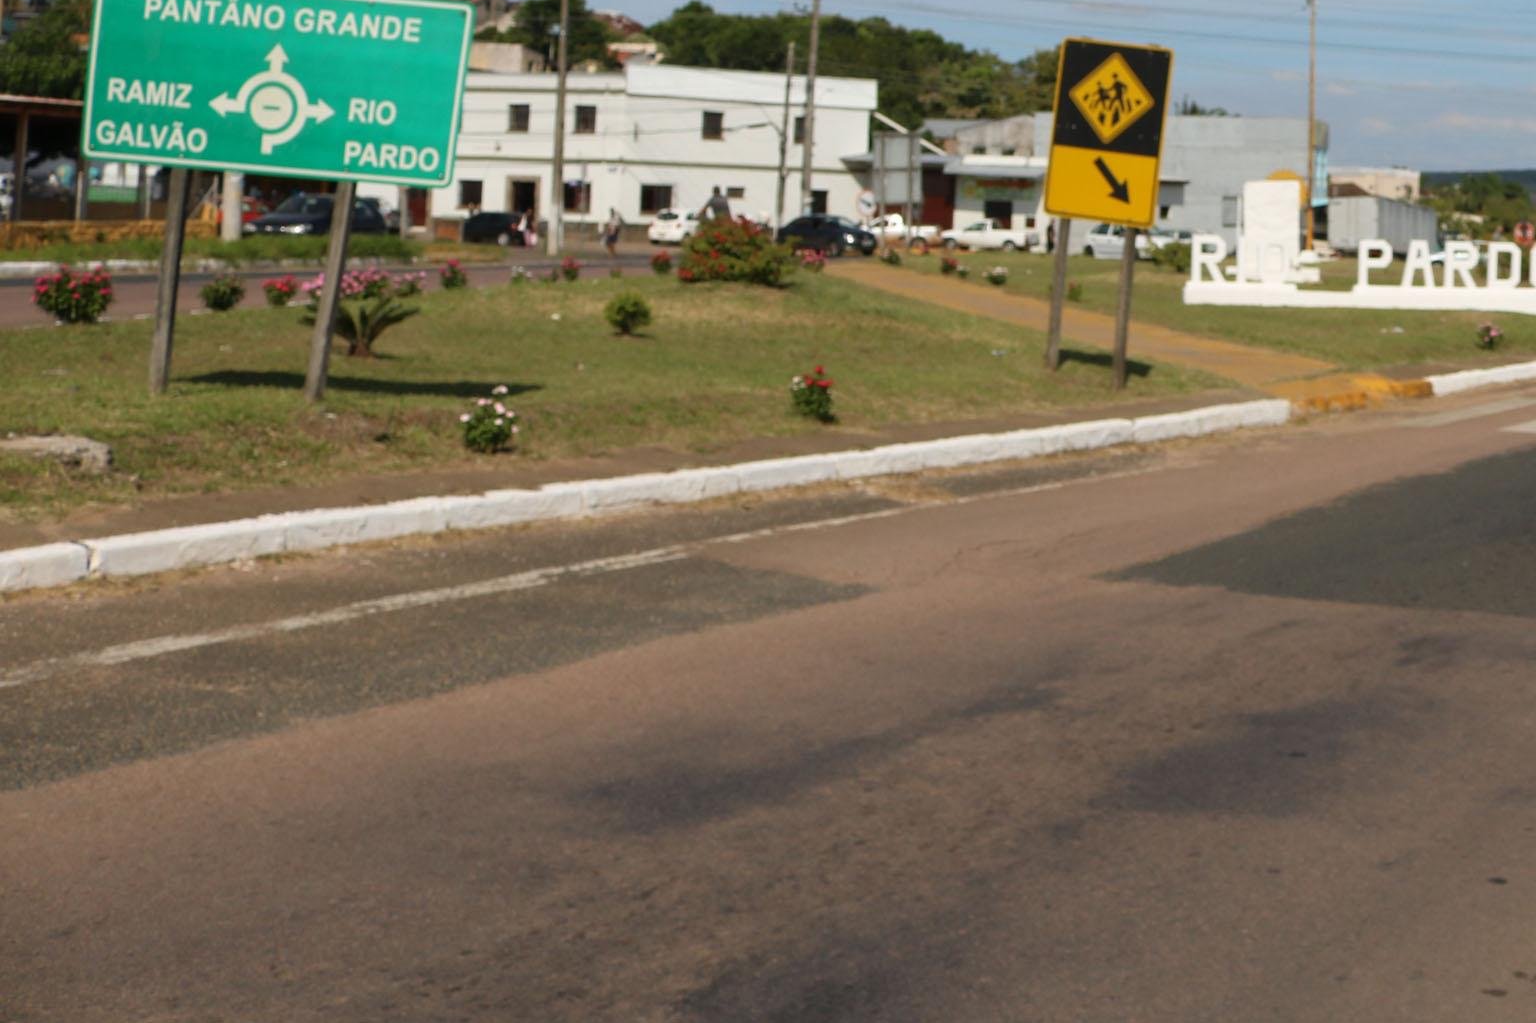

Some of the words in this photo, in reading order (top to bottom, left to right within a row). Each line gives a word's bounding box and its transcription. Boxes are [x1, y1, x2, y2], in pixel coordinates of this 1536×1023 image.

[293, 6, 423, 43] GRANDE
[107, 77, 193, 109] RAMIZ
[347, 97, 397, 126] RIO
[95, 119, 208, 154] GALVÃO
[343, 140, 441, 173] PARDO
